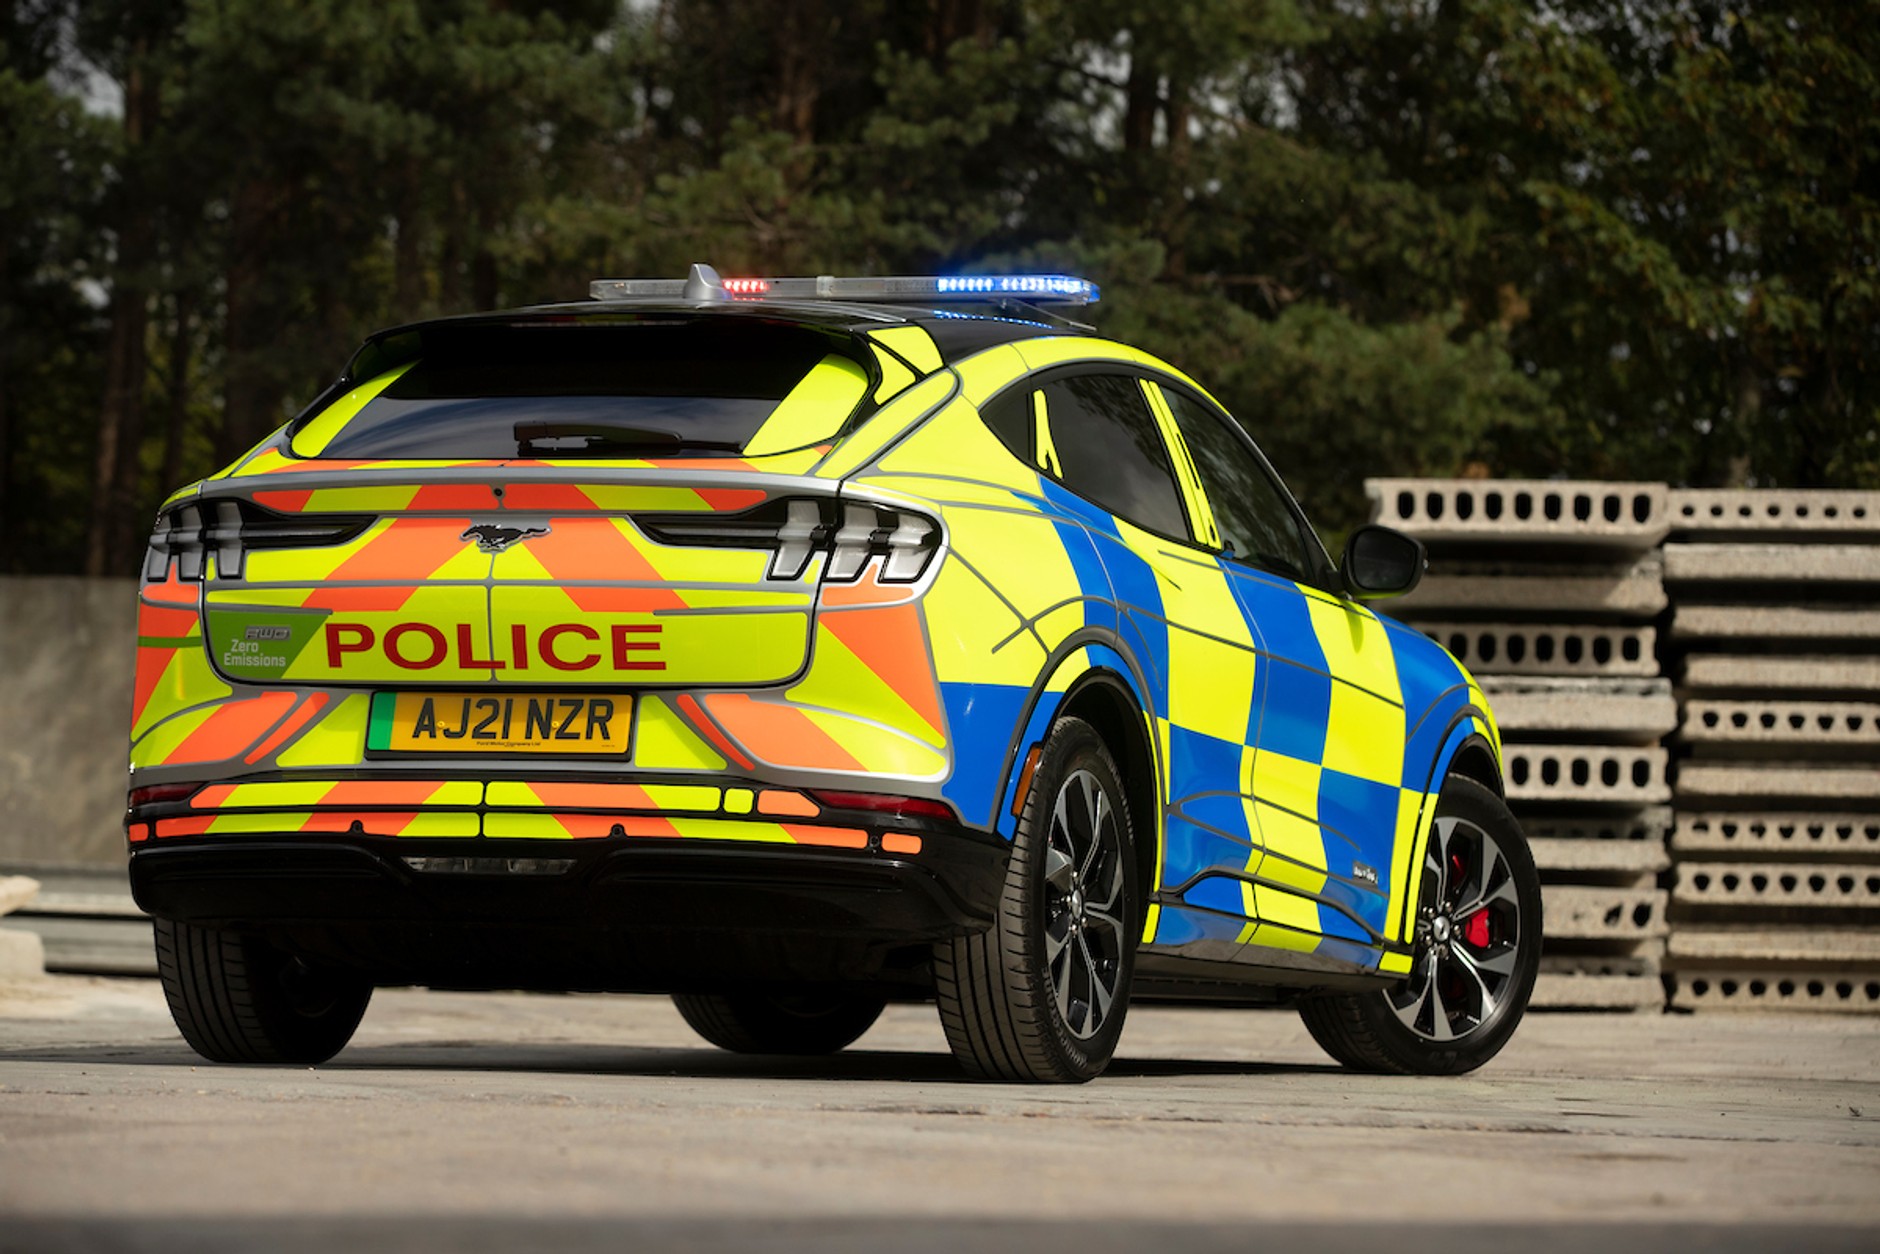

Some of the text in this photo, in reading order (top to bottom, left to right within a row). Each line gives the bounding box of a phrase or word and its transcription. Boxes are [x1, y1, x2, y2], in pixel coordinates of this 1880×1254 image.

[224, 653, 286, 667] Emissions
[231, 639, 259, 652] Zero
[325, 622, 667, 671] POLICE
[412, 697, 614, 741] AJ21 NZR
